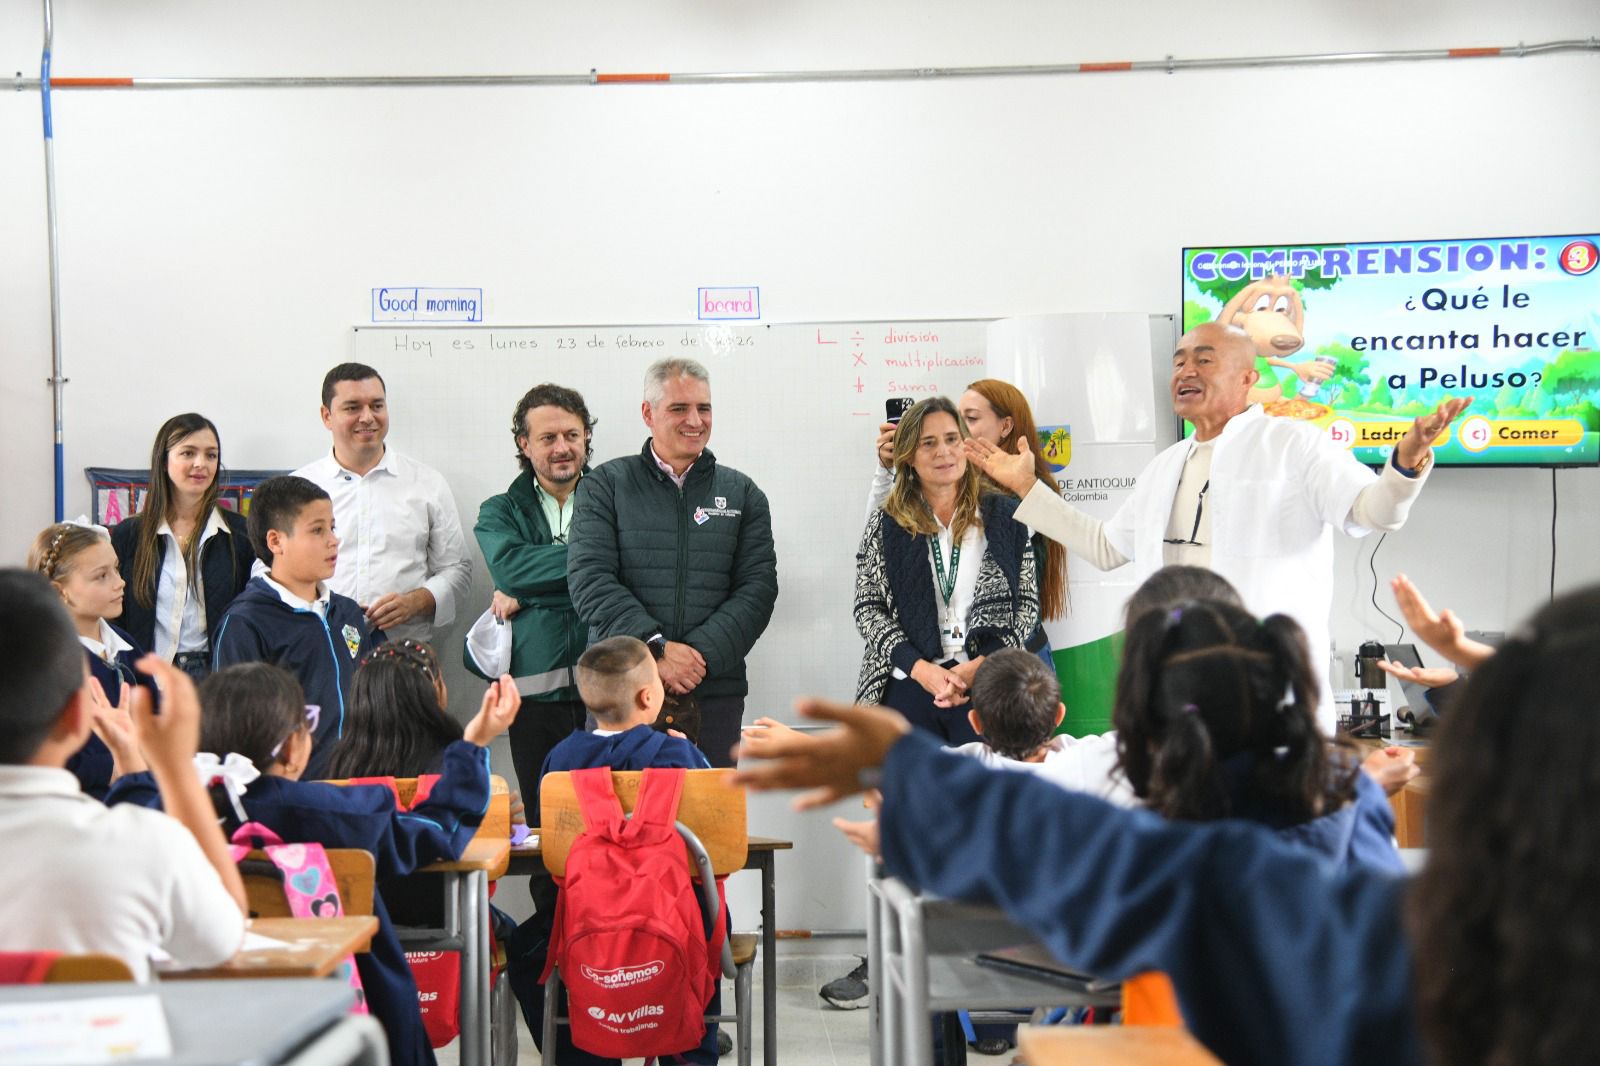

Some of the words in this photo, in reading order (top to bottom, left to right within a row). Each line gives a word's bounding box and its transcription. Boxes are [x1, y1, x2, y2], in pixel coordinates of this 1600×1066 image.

[1190, 243, 1547, 281] COMPRENSION:
[1568, 245, 1589, 269] 3
[379, 287, 418, 311] Good
[426, 297, 476, 321] morning
[704, 290, 753, 312] board
[1405, 286, 1490, 312] ¿Qué
[1502, 285, 1531, 309] le
[395, 334, 433, 357] Hoy
[452, 339, 475, 350] es
[490, 333, 538, 350] lunes
[557, 338, 577, 349] 23
[586, 334, 605, 349] de
[616, 334, 665, 349] febrero
[680, 332, 697, 346] de
[1350, 327, 1480, 352] encanta
[1492, 324, 1587, 348] hacer
[885, 351, 984, 371] multiplicación
[1388, 370, 1407, 390] a
[1419, 364, 1542, 390] Peluso?
[1498, 426, 1559, 440] Comer
[1057, 479, 1073, 490] DE
[1076, 477, 1137, 489] ANTIOQUIA
[1063, 492, 1108, 502] Colombia
[607, 1012, 626, 1024] AV
[627, 1004, 664, 1022] Villas
